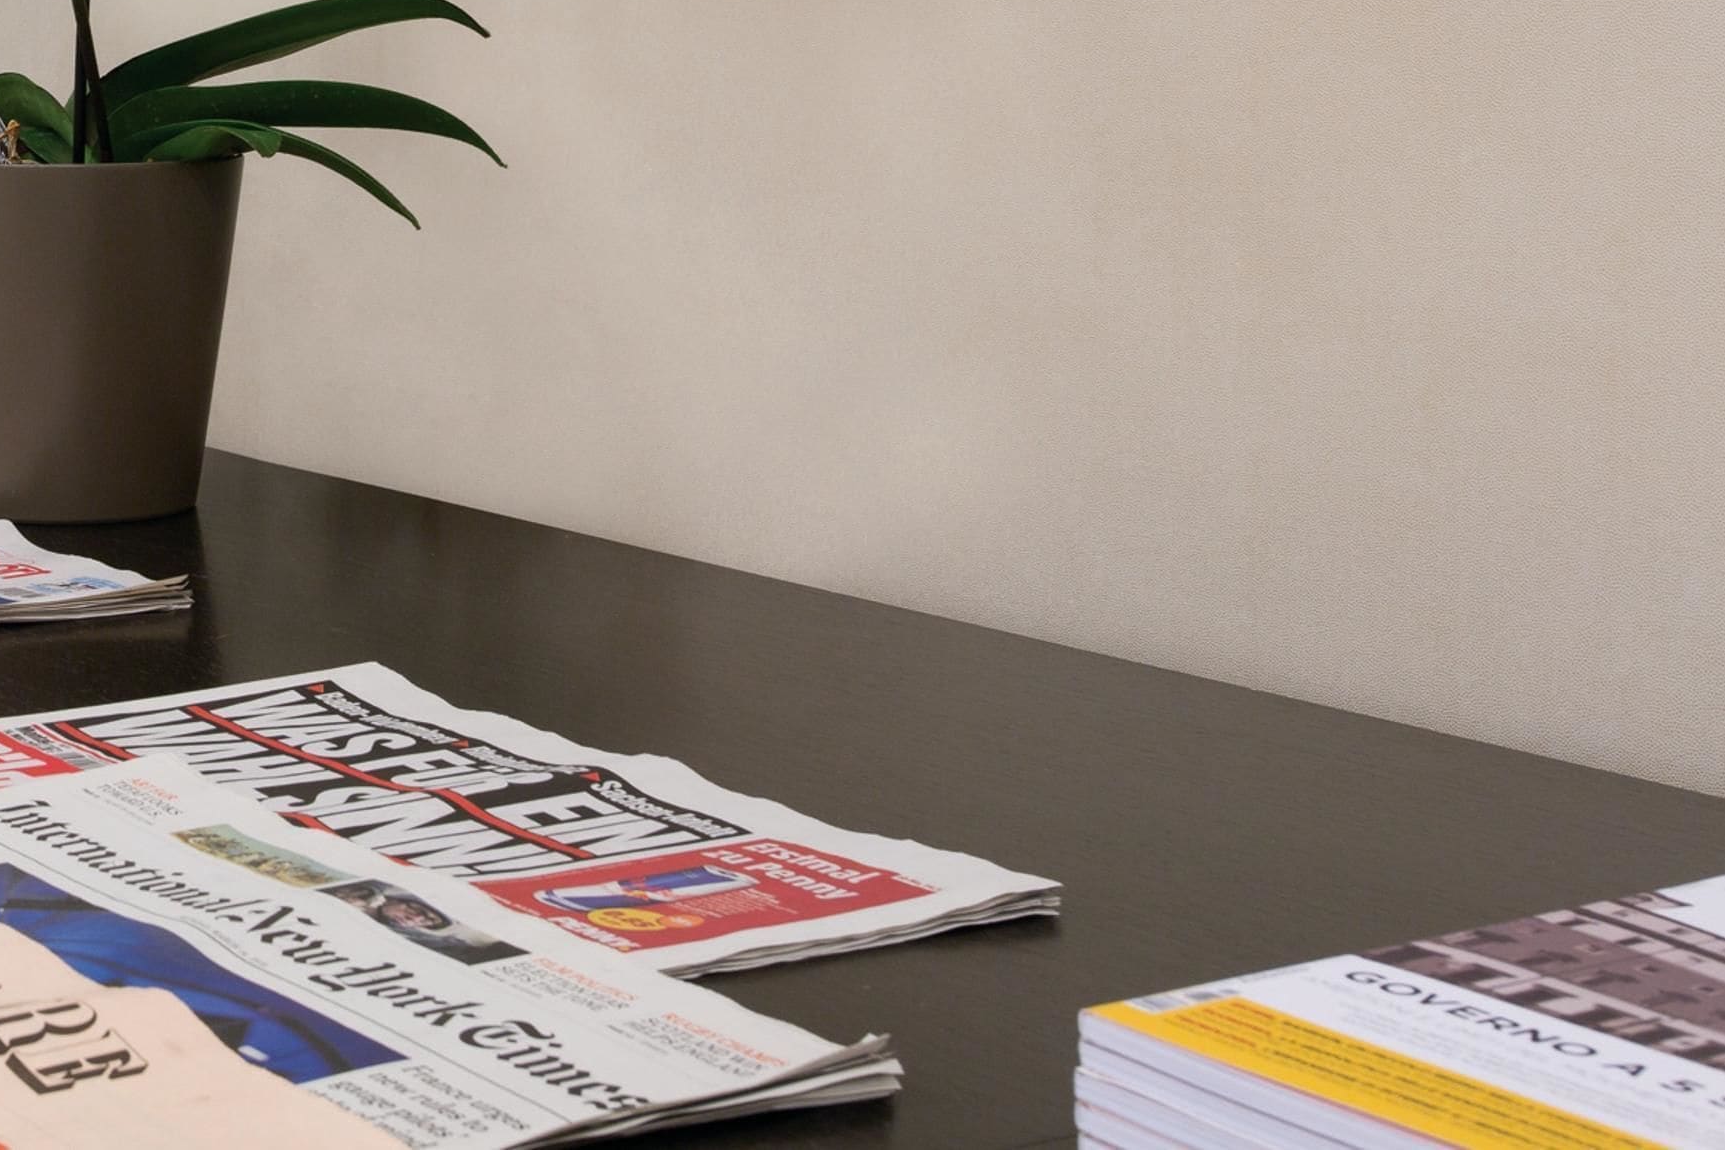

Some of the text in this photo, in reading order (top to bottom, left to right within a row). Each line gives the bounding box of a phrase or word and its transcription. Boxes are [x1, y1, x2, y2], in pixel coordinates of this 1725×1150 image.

[224, 690, 419, 759] WAS
[497, 791, 705, 856] EIN
[745, 861, 858, 899] Penny
[748, 843, 880, 884] Erstmal
[242, 906, 356, 967] New
[307, 958, 484, 1030] York
[457, 1018, 650, 1112] Times
[1345, 969, 1598, 1058] GOVERNO
[1602, 1062, 1647, 1077] A
